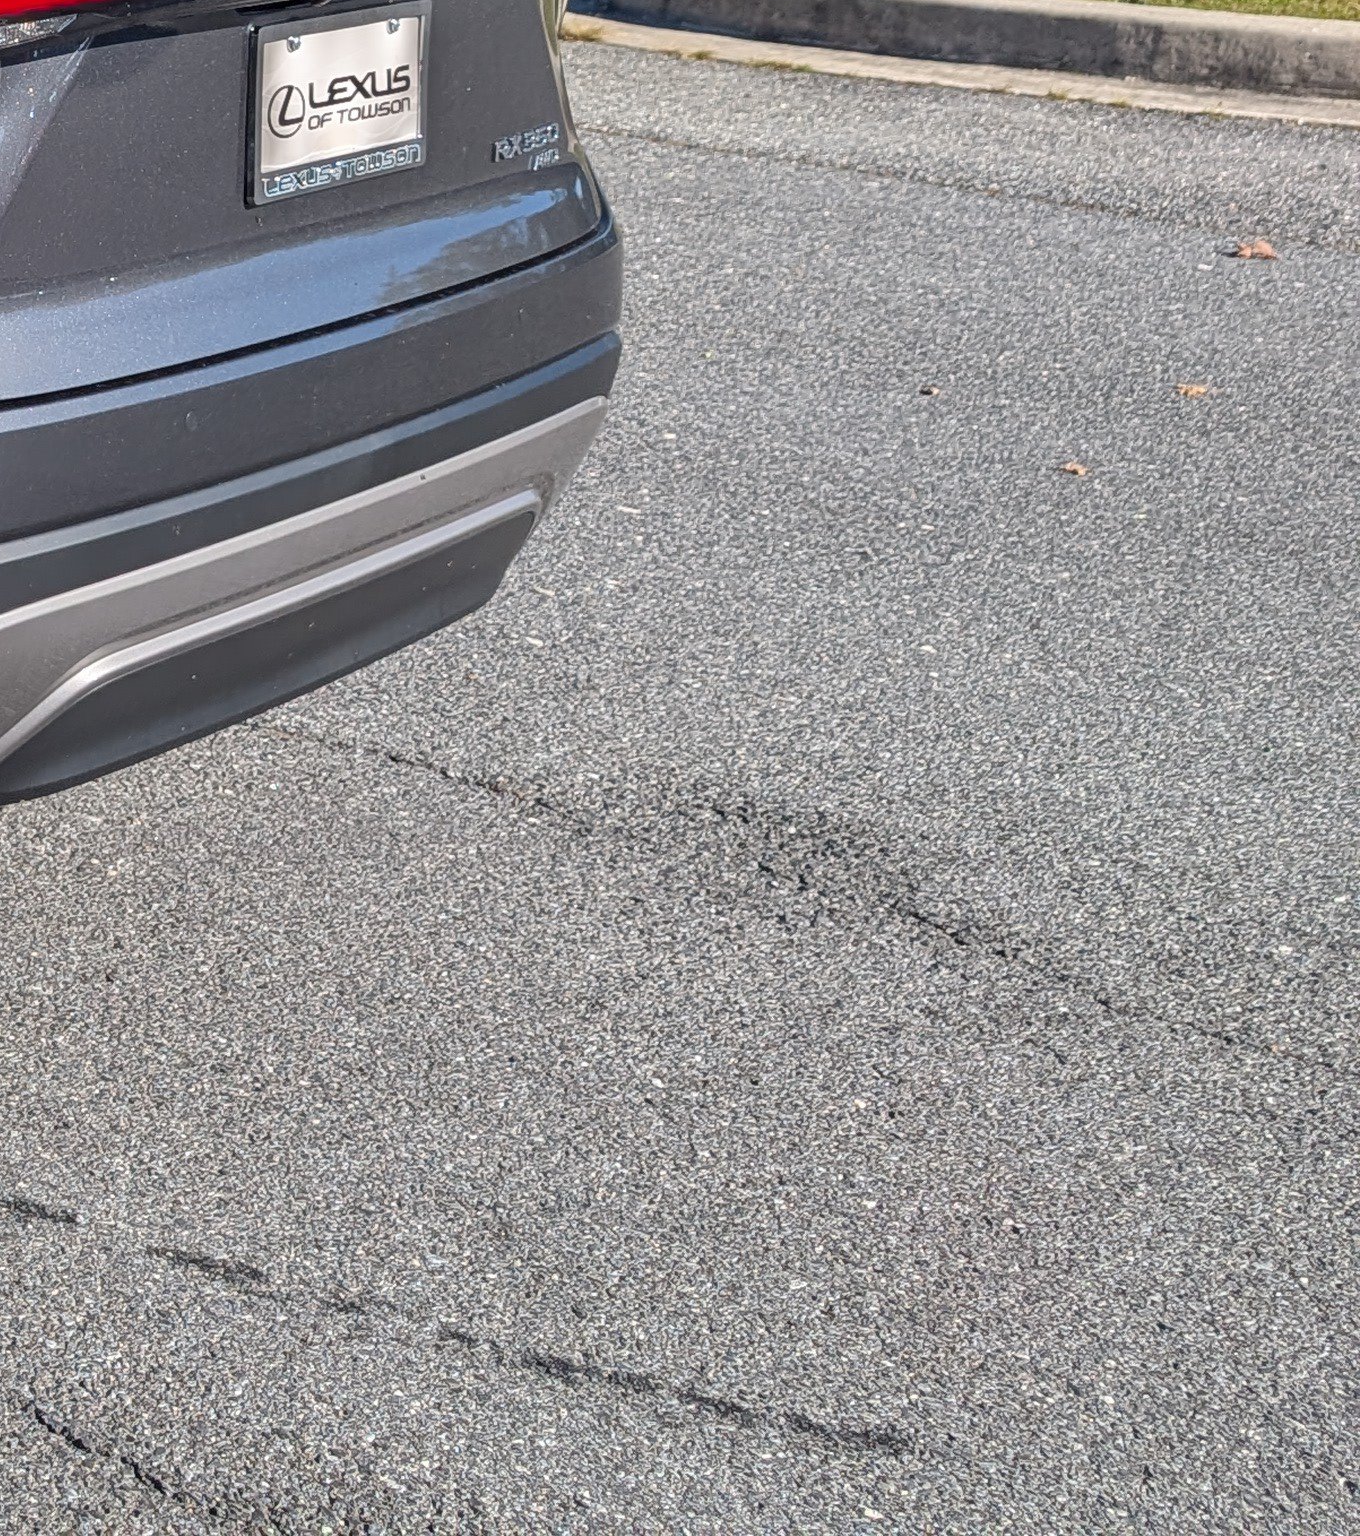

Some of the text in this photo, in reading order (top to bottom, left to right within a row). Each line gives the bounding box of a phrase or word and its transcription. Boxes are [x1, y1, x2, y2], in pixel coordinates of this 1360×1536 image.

[308, 64, 411, 109] LEXUS
[307, 96, 411, 130] OF TOWSON
